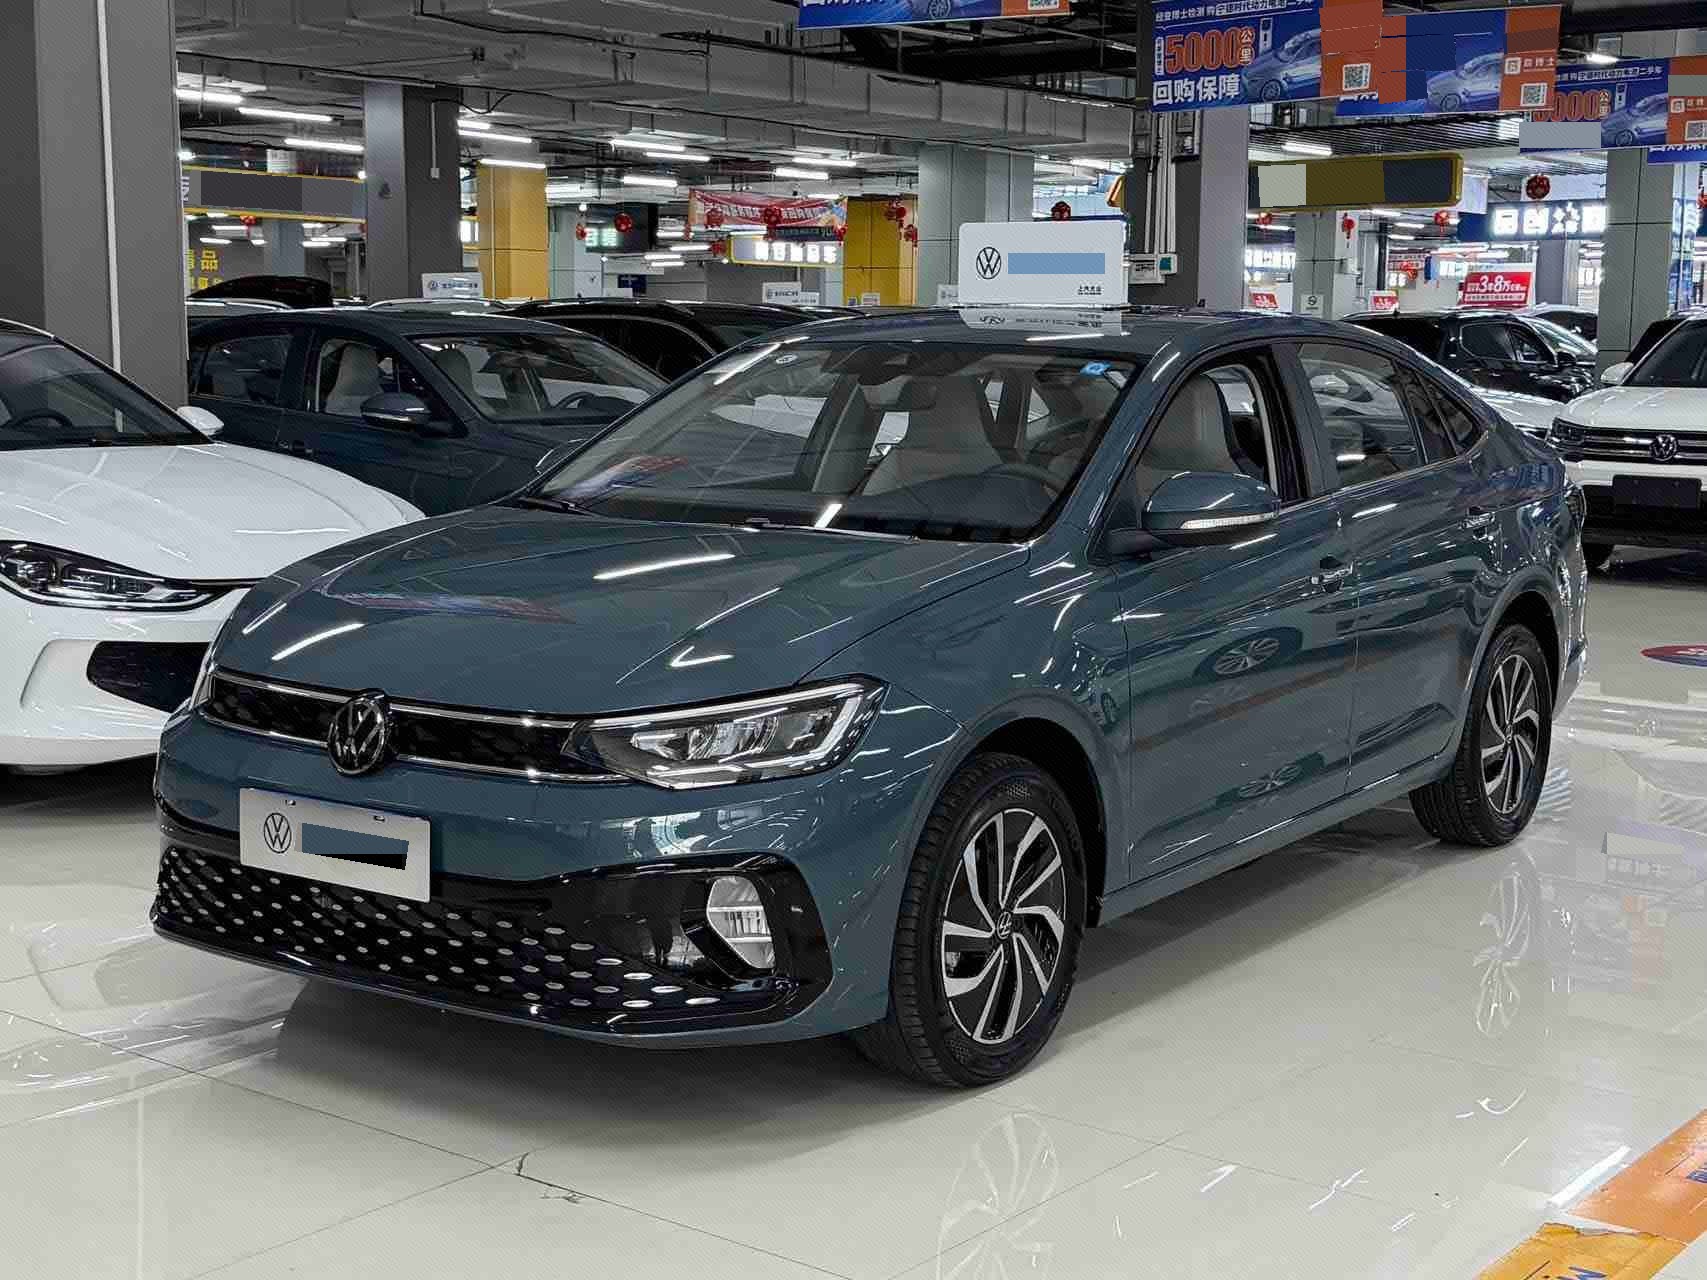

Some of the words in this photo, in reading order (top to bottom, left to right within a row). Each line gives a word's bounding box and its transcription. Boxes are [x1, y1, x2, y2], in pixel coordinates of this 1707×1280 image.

[1165, 28, 1242, 75] 5000
[1152, 73, 1240, 106] 回购保障
